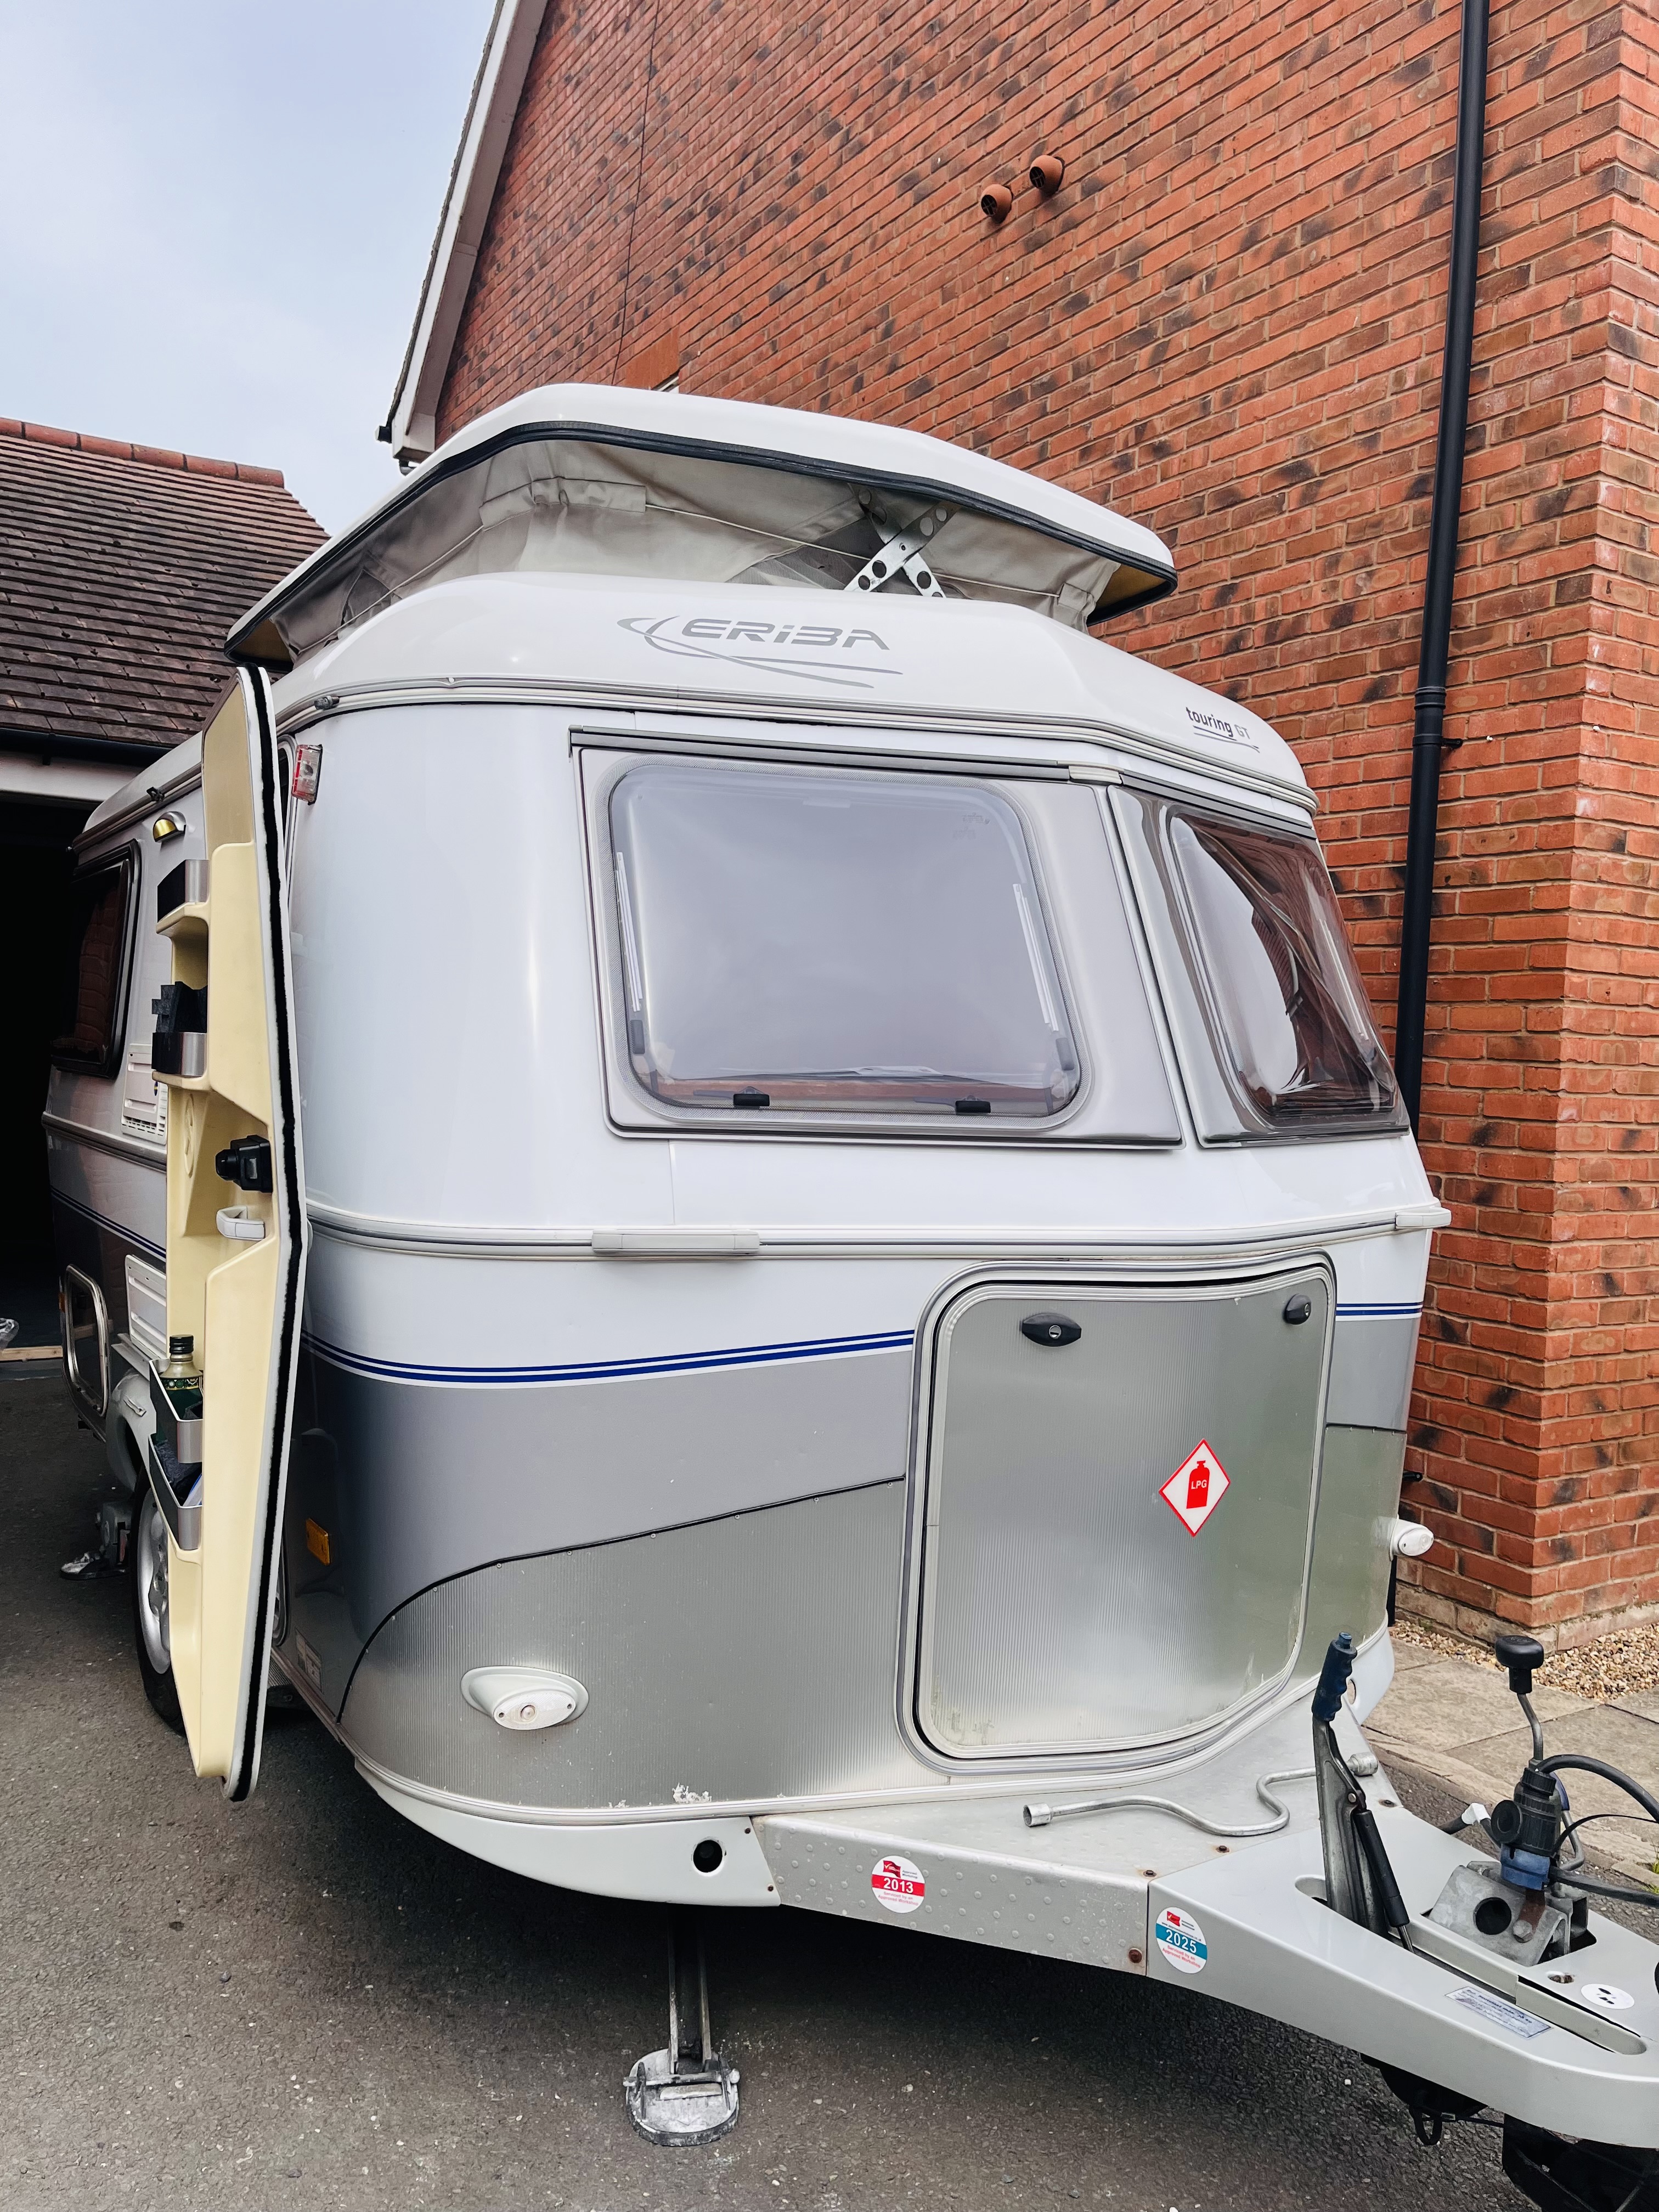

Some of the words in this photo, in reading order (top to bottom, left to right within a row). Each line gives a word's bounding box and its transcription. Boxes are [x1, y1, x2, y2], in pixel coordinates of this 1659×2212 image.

[1185, 706, 1234, 737] touring
[1234, 724, 1250, 740] GT
[1191, 1479, 1207, 1489] LPG
[883, 1877, 914, 1894] 2013
[1166, 1929, 1197, 1954] 2025
